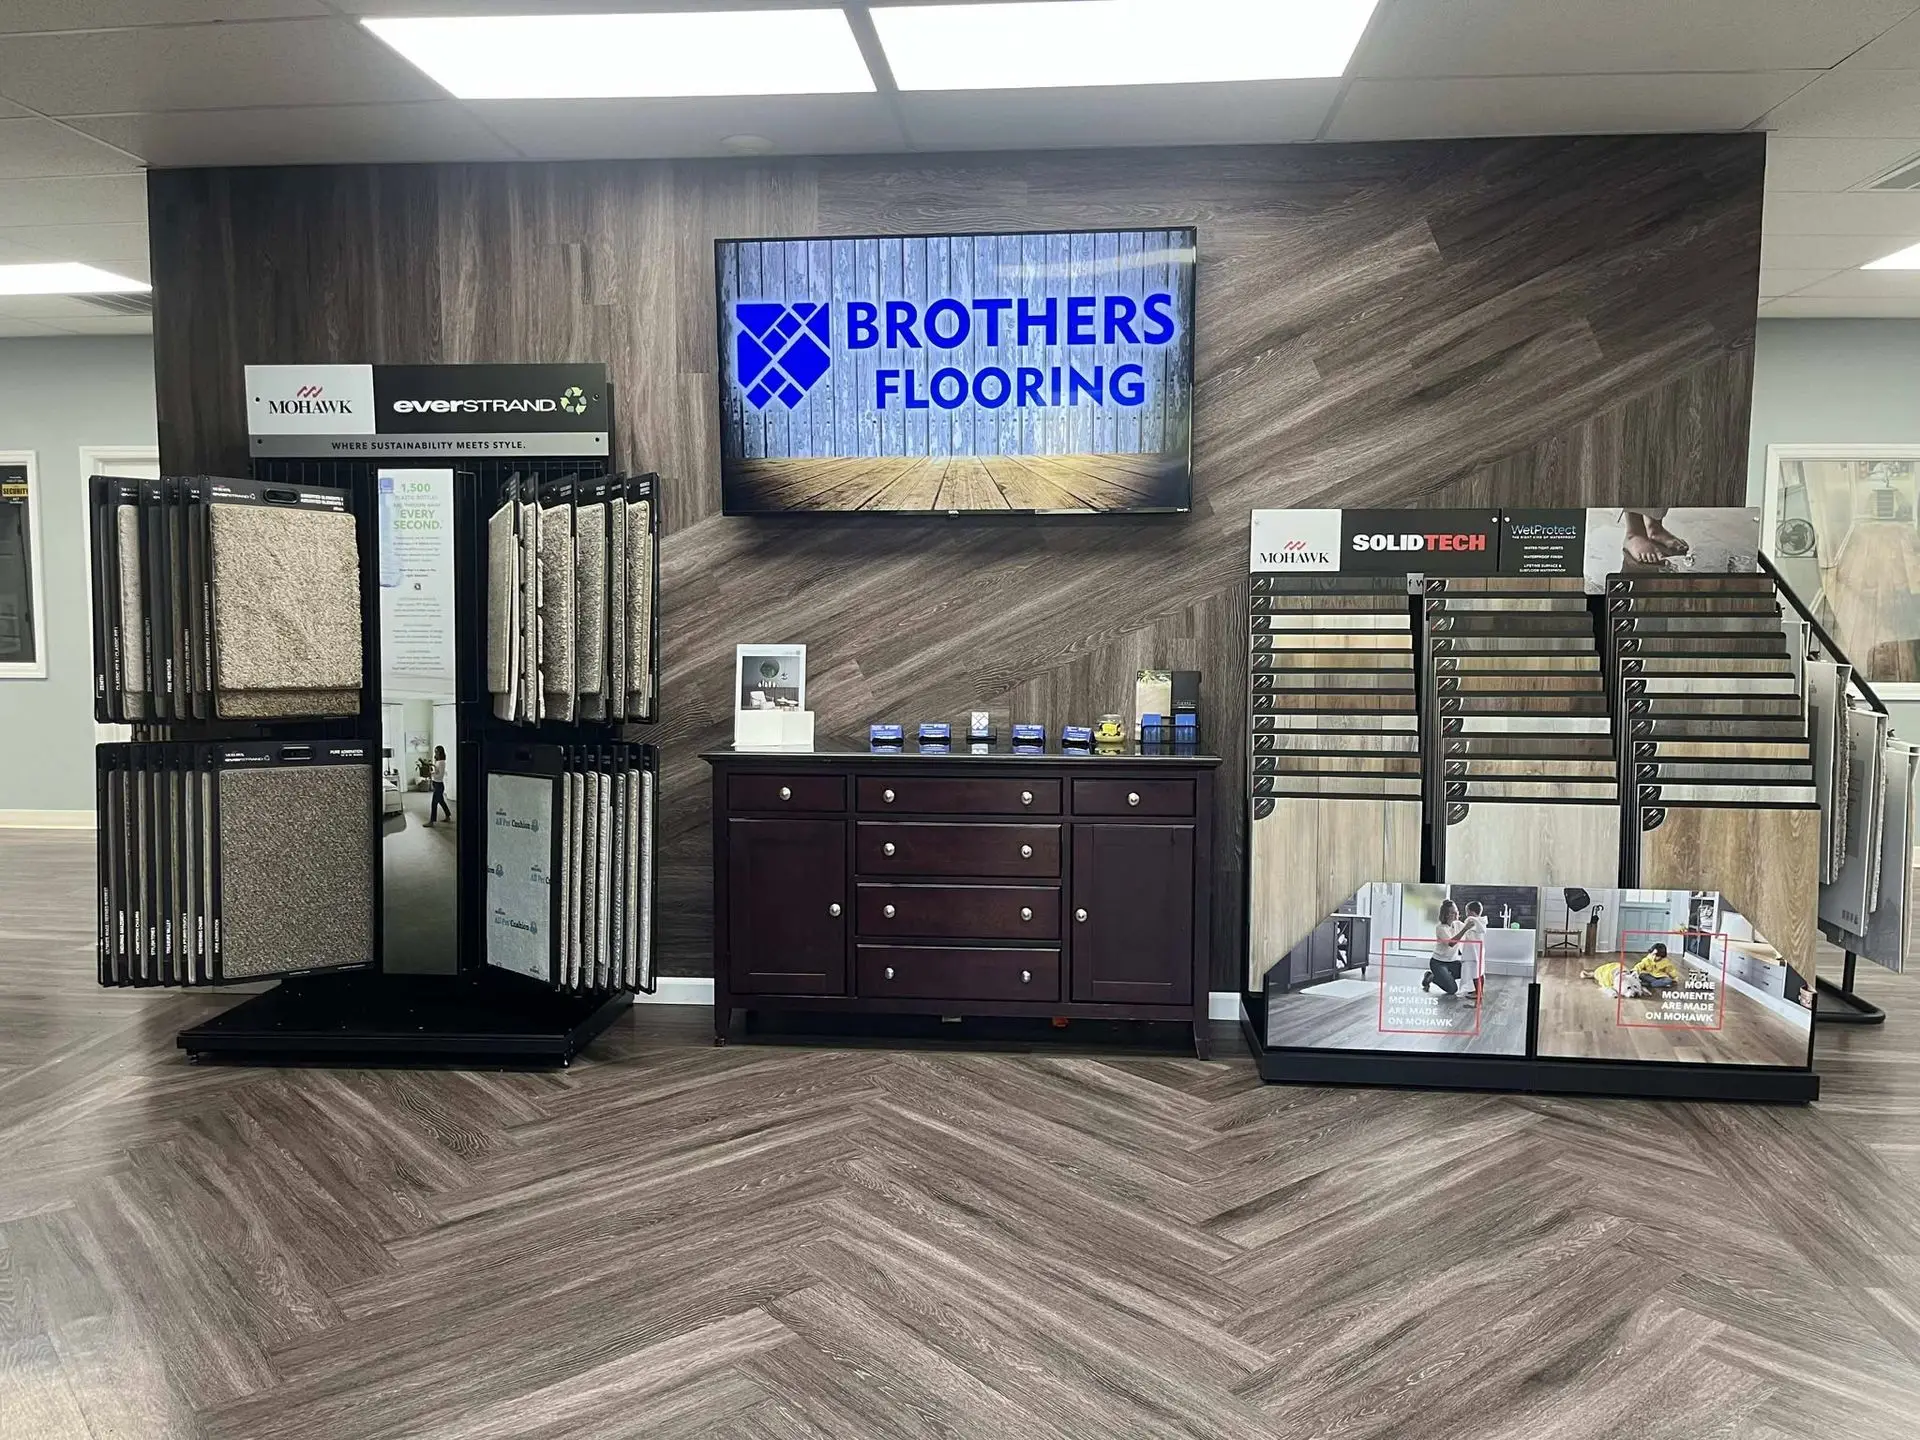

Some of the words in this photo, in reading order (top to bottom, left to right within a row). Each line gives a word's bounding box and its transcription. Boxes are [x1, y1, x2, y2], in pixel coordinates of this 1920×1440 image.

[846, 293, 1175, 349] BROTHERS
[876, 363, 1145, 409] FLOORING
[269, 399, 353, 414] MOHAWK
[331, 441, 367, 450] WHERE
[371, 441, 453, 450] SUSTAINABILITY
[456, 440, 490, 450] MEETS
[492, 440, 526, 450] STYLE.
[401, 483, 431, 492] 1,500
[400, 509, 435, 518] EVERY
[393, 520, 443, 530] SECOND.
[1511, 525, 1577, 535] WetProtect
[1352, 534, 1486, 552] SOLIDTECH
[1260, 552, 1330, 565] MOHAWK
[511, 819, 531, 830] Cushion
[510, 919, 529, 931] Cushion
[1685, 981, 1715, 990] MORE
[1389, 996, 1439, 1005] MOMENTS
[1662, 991, 1715, 1000] MOMENTS
[1388, 1007, 1407, 1015] ARE
[1661, 1001, 1682, 1010] ARE
[1684, 1003, 1714, 1011] MADE
[1388, 1017, 1402, 1025] ON
[1406, 1017, 1453, 1026] MOHAWK
[1645, 1012, 1661, 1020] ON
[1664, 1013, 1713, 1022] MOHAWK
